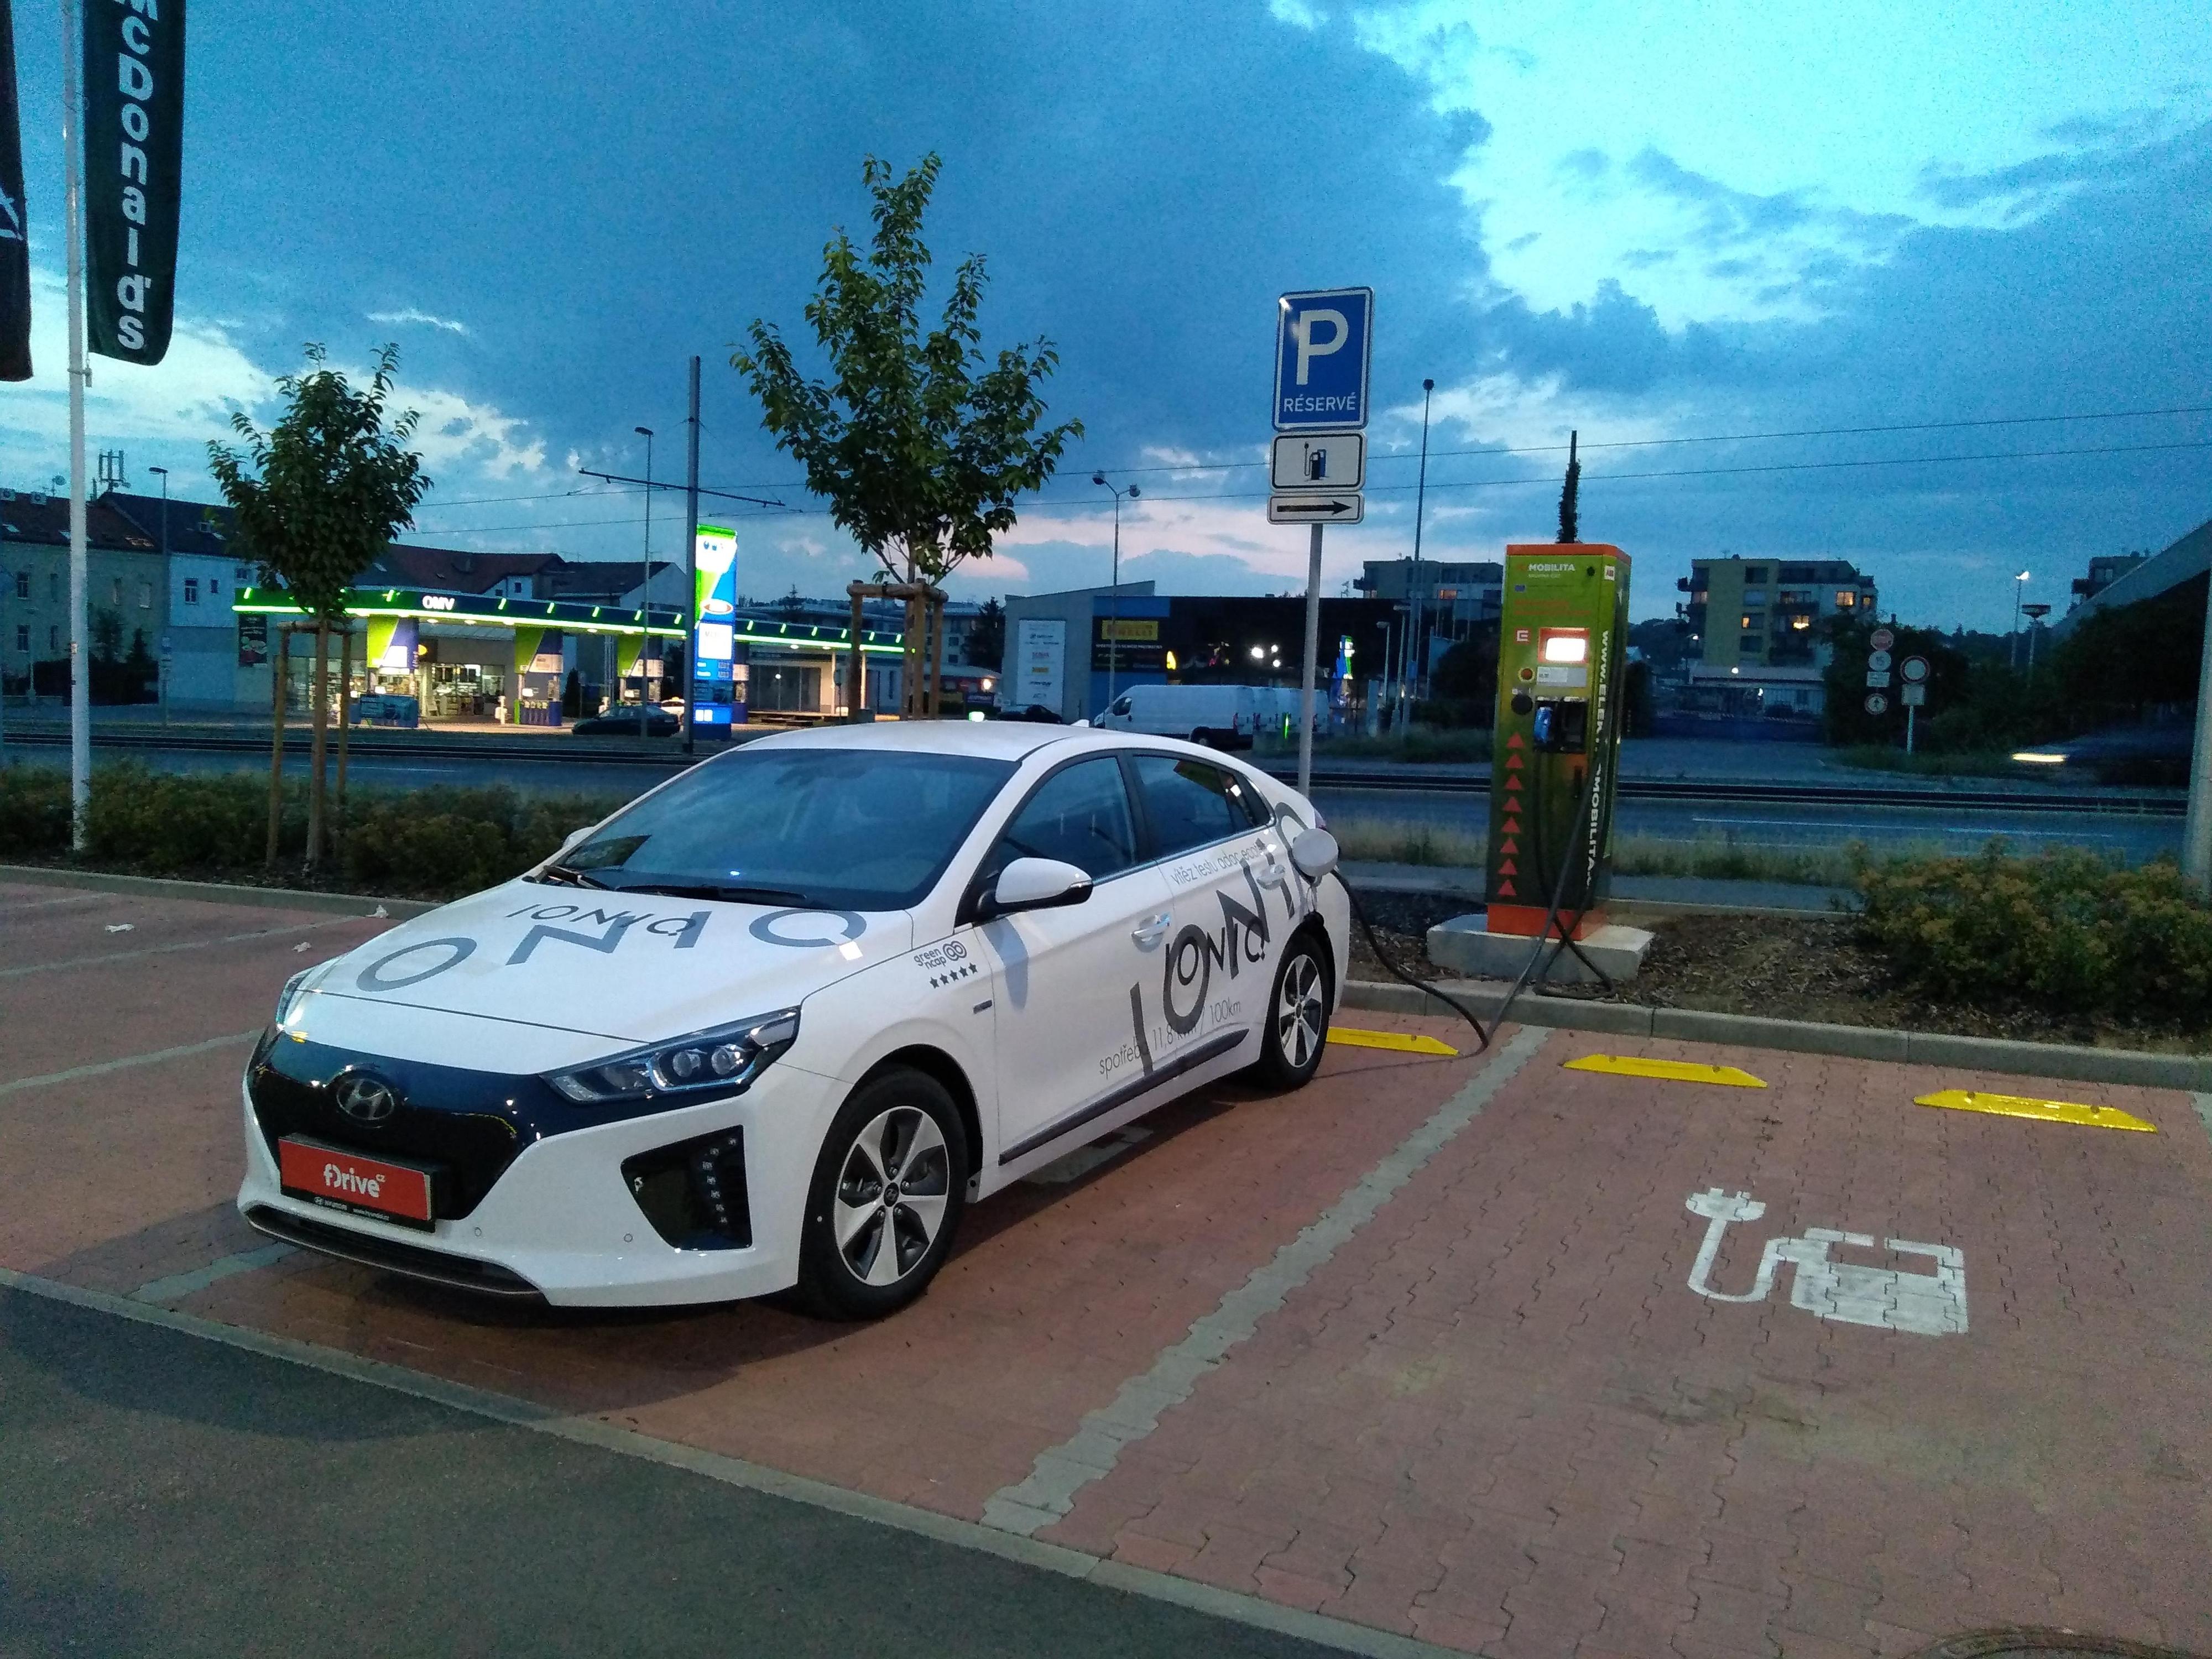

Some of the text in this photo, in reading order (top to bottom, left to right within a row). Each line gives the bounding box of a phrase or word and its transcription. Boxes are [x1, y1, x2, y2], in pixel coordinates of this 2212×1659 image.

[1296, 309, 1348, 385] P
[1284, 392, 1356, 412] RÉSERVÉ
[422, 596, 455, 611] OMV
[504, 904, 696, 936] IONIQ
[914, 948, 942, 967] green
[924, 956, 947, 969] ncap
[1209, 997, 1241, 1025] 100km
